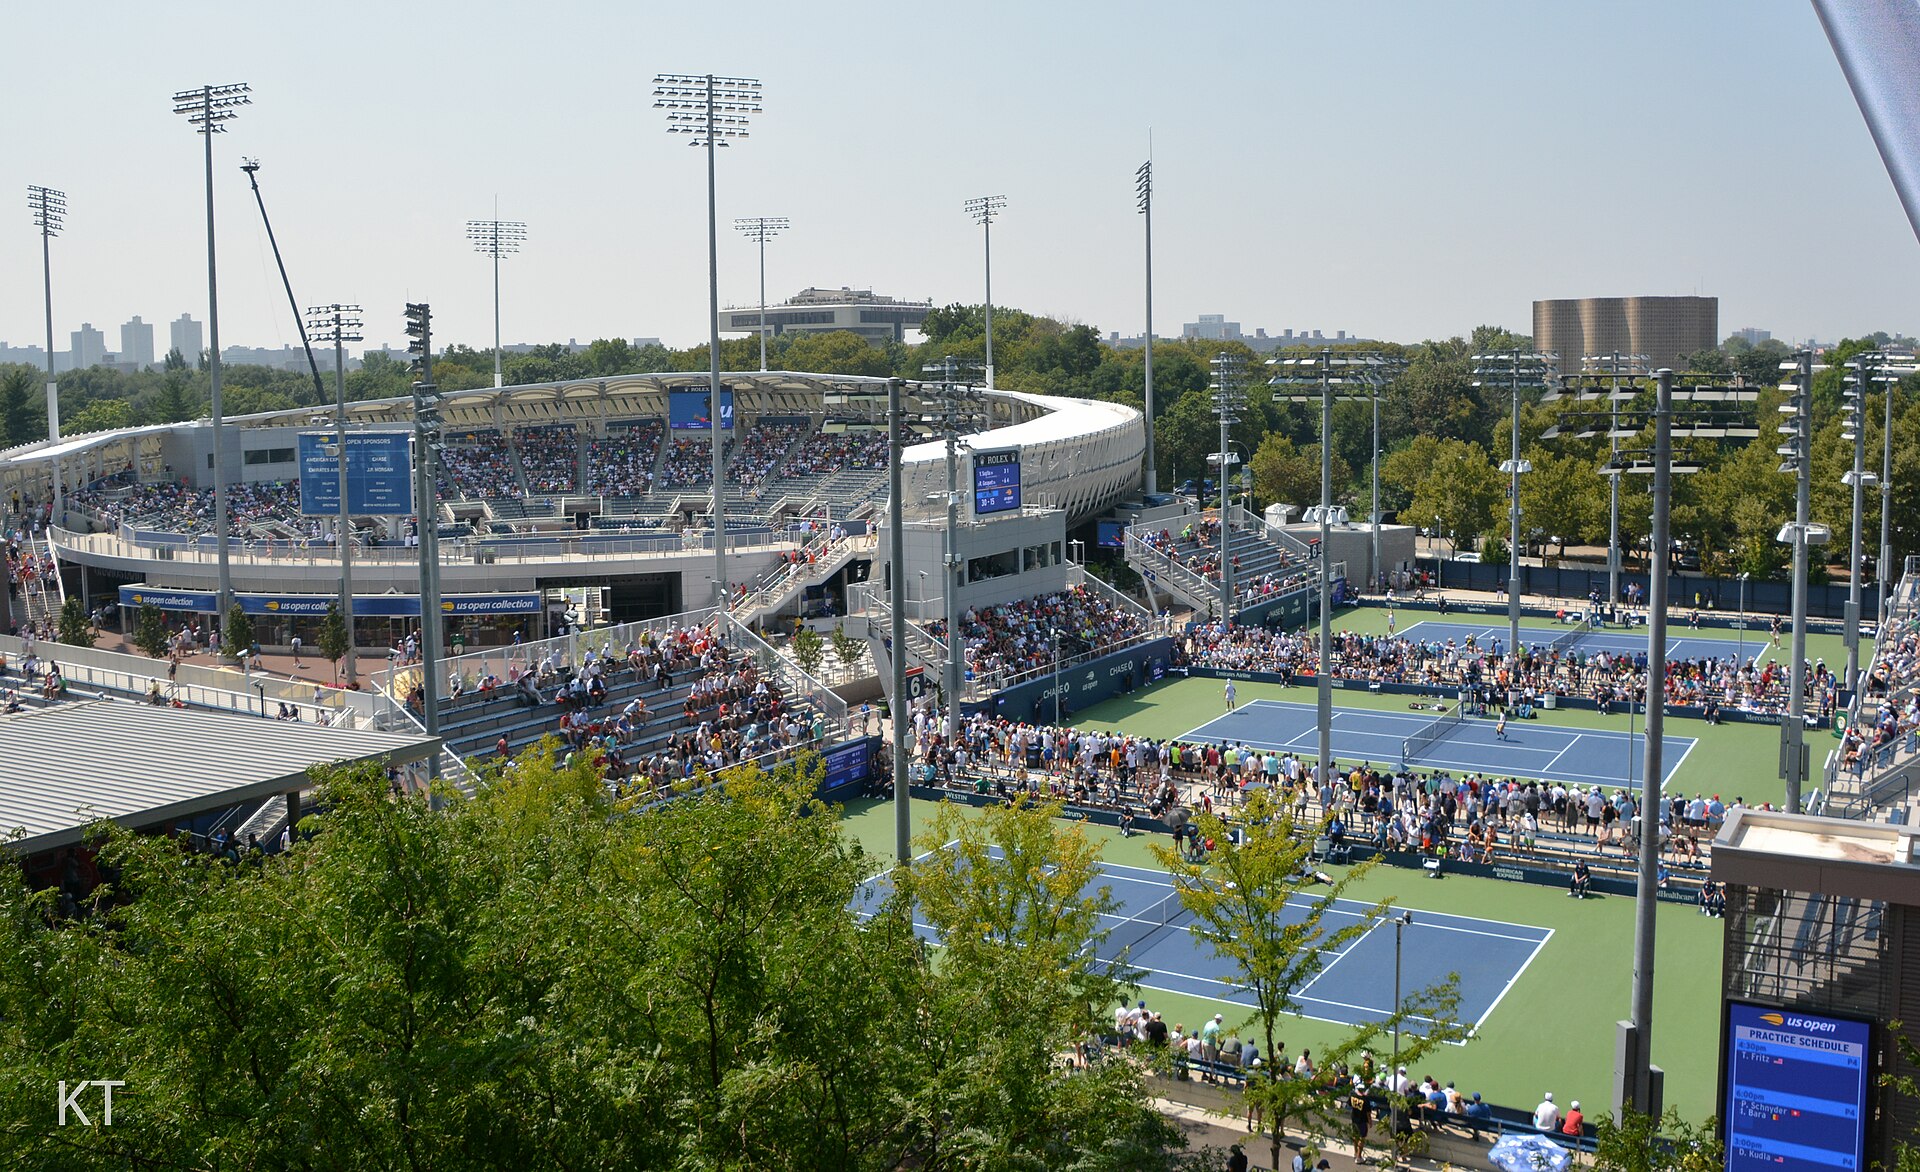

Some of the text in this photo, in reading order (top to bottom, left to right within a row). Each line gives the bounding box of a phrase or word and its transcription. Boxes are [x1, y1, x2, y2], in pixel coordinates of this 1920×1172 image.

[987, 455, 1008, 464] ROLEX
[1312, 544, 1317, 557] 6
[150, 596, 165, 606] open
[165, 596, 194, 606] collection
[468, 602, 490, 612] open
[492, 600, 533, 610] collection
[289, 602, 310, 612] open
[1110, 664, 1128, 676] CHASE
[911, 677, 920, 697] 6
[1746, 713, 1782, 723] Mercedes-B
[1492, 867, 1523, 876] AMERICAN
[1657, 890, 1695, 901] dHealthcare
[1787, 1017, 1836, 1032] us open
[1750, 1030, 1849, 1053] PRACTICE SCHEDULE
[1751, 1052, 1769, 1063] Fritz
[1749, 1109, 1766, 1119] Bara
[1751, 1102, 1787, 1115] Schnyder
[1749, 1149, 1771, 1161] Kudla
